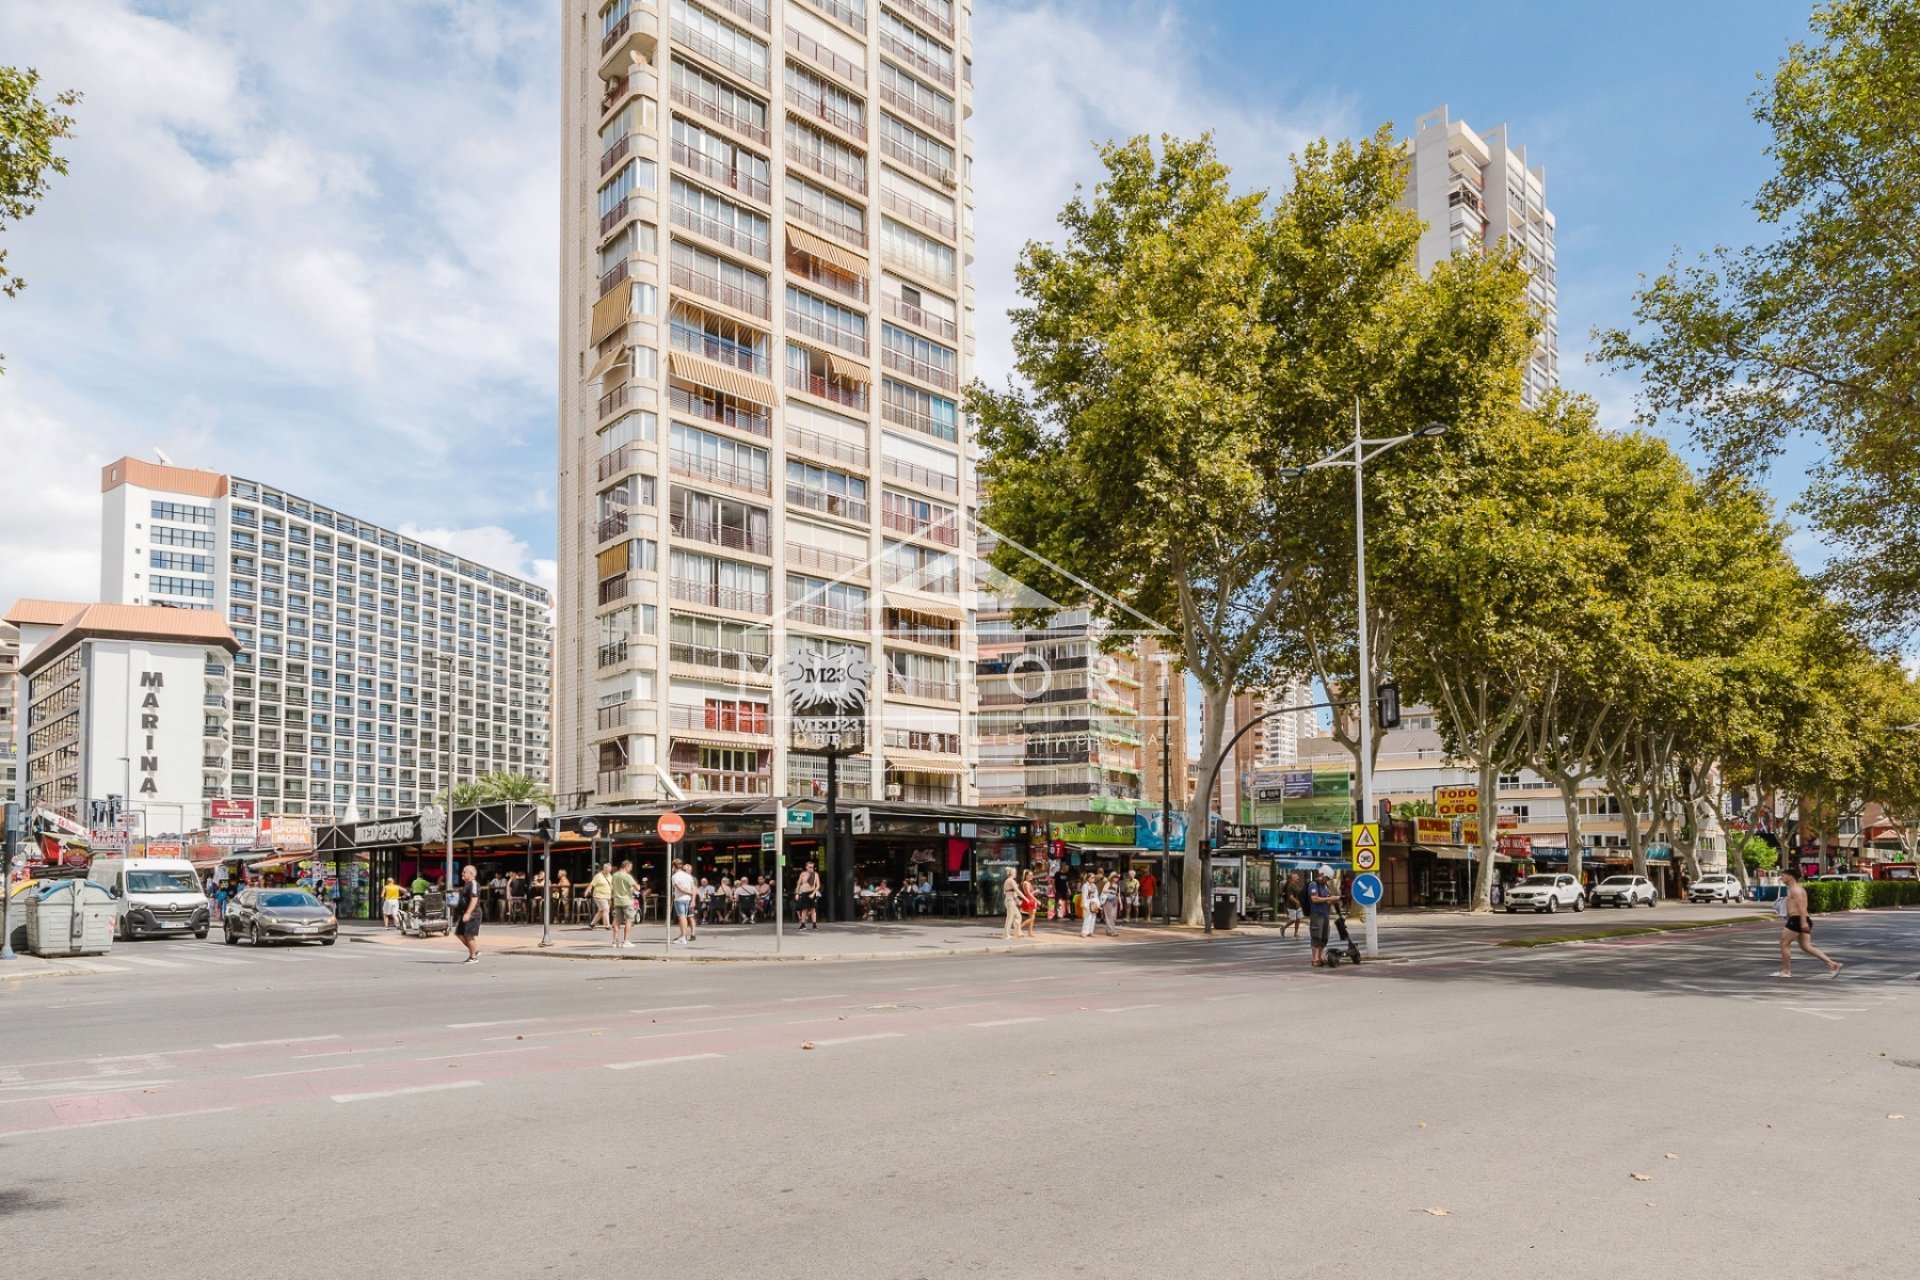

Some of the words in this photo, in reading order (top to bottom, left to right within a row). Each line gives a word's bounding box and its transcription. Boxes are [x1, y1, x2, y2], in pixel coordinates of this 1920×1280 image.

[805, 667, 847, 684] M23
[793, 718, 860, 733] MED23
[139, 671, 164, 794] MARINA
[1440, 789, 1478, 799] TODO
[95, 830, 125, 838] SUPER
[273, 826, 310, 835] SPORTS
[1063, 826, 1088, 836] SPORT
[1090, 827, 1134, 837] SOUVENIRS
[93, 837, 127, 846] MARKET
[211, 837, 235, 846] SPORT
[236, 837, 254, 845] SHOP
[276, 834, 307, 843] MODA
